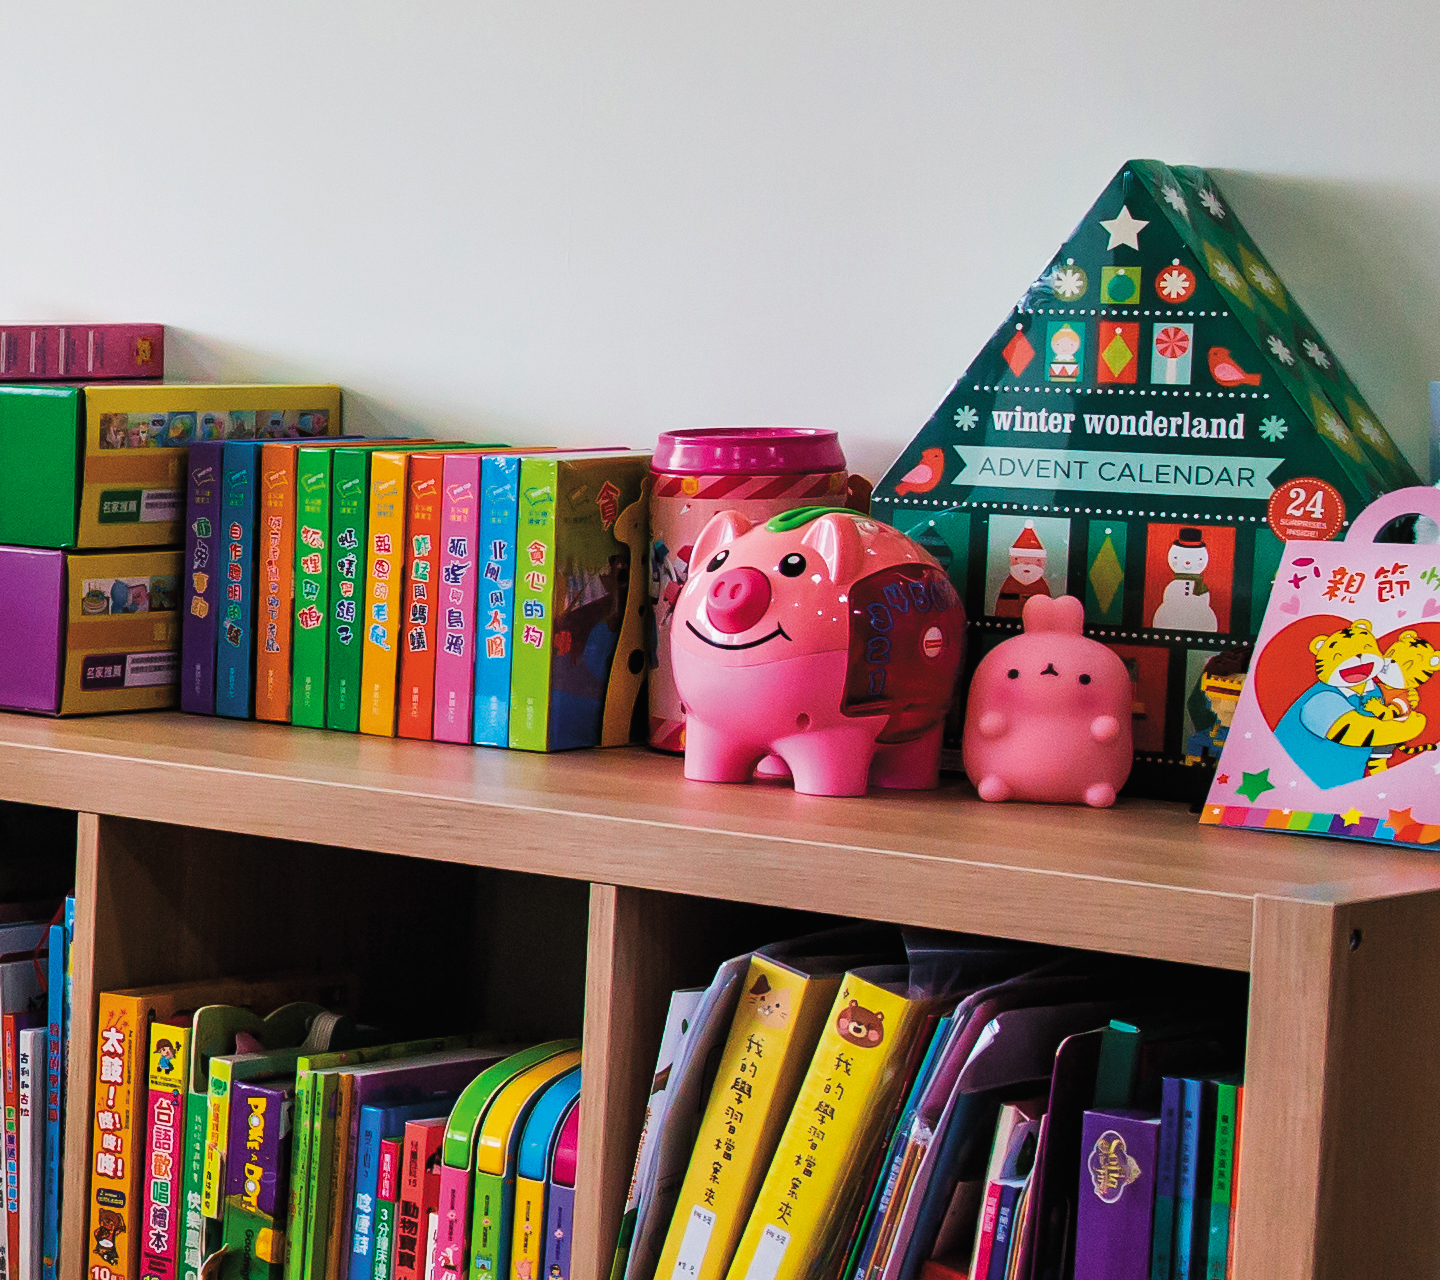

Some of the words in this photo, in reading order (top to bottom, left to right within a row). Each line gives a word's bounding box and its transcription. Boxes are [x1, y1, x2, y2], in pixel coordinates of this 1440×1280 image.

[991, 406, 1075, 434] winter
[1083, 409, 1245, 441] wonderland
[979, 456, 1088, 484] ADVENT
[1097, 459, 1255, 488] CALENDAR
[1286, 488, 1325, 518] 24
[523, 540, 546, 648] 貪心的狗
[246, 1097, 268, 1150] POKE
[704, 1033, 765, 1206] 我的學習檔案夾
[777, 1053, 855, 1226] 我的學習檔案夾
[241, 1163, 264, 1213] DOT!
